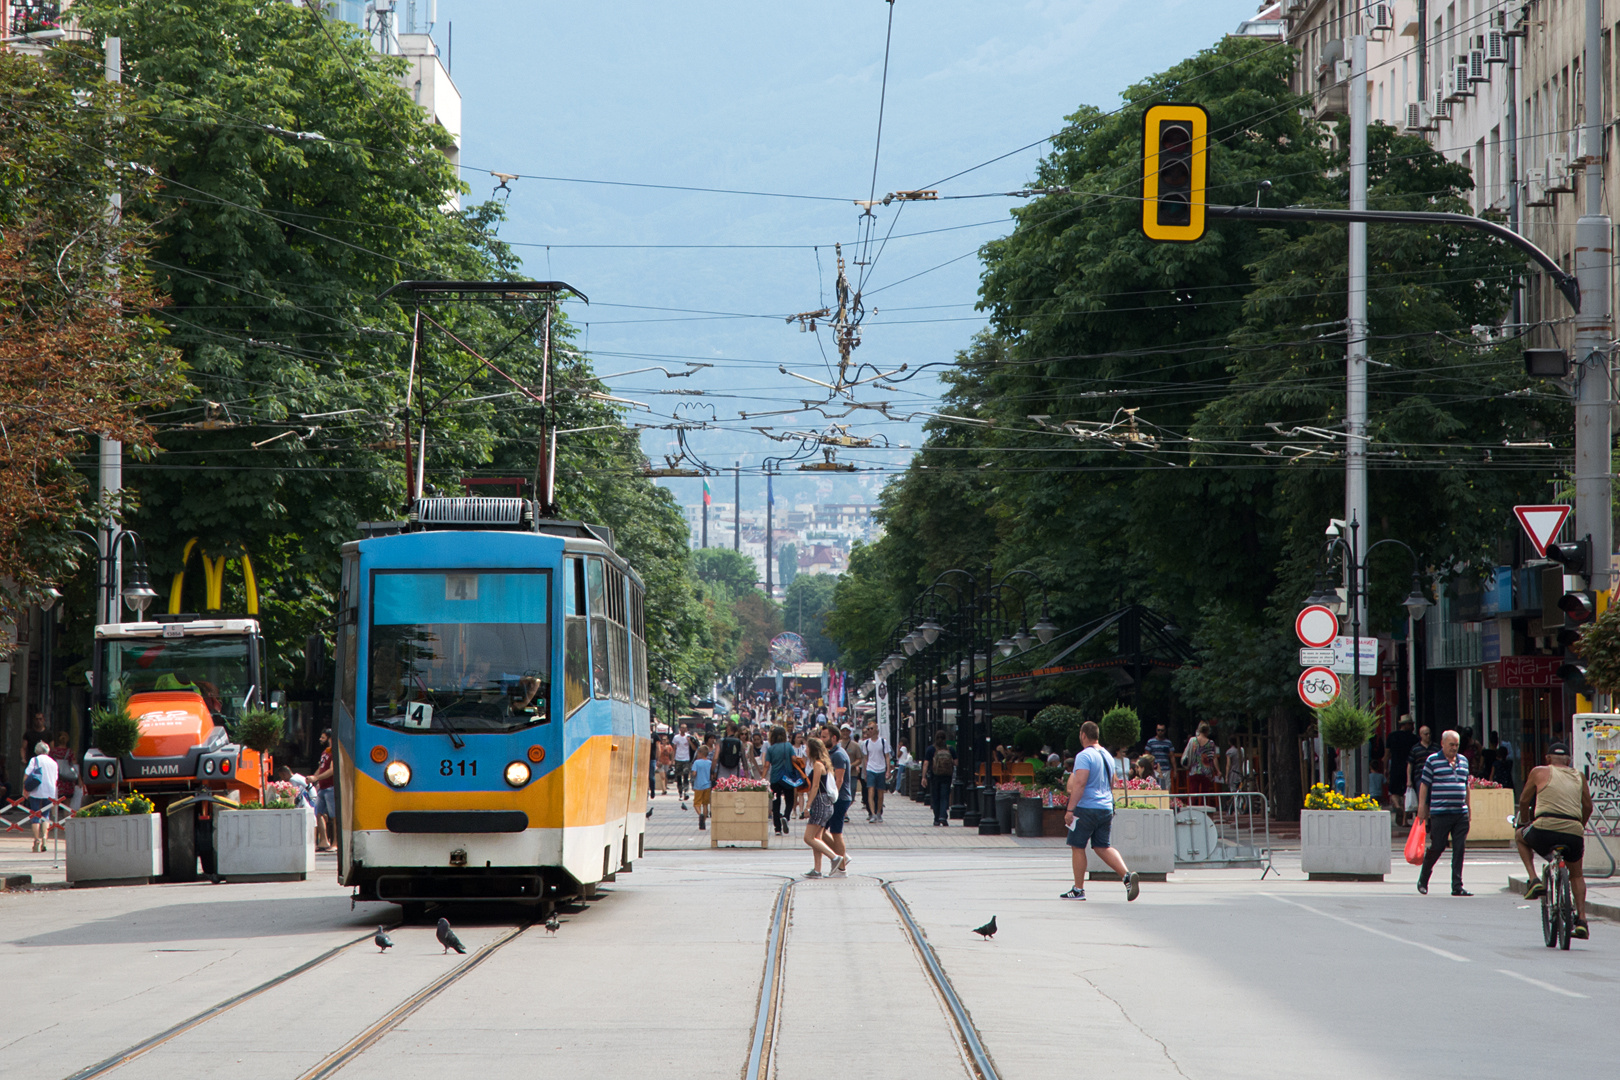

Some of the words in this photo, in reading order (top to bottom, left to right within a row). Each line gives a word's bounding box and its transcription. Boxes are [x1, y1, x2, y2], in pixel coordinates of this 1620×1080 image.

[455, 579, 468, 600] 4
[411, 704, 424, 726] 4
[141, 764, 179, 775] HAMM
[439, 760, 477, 776] 811
